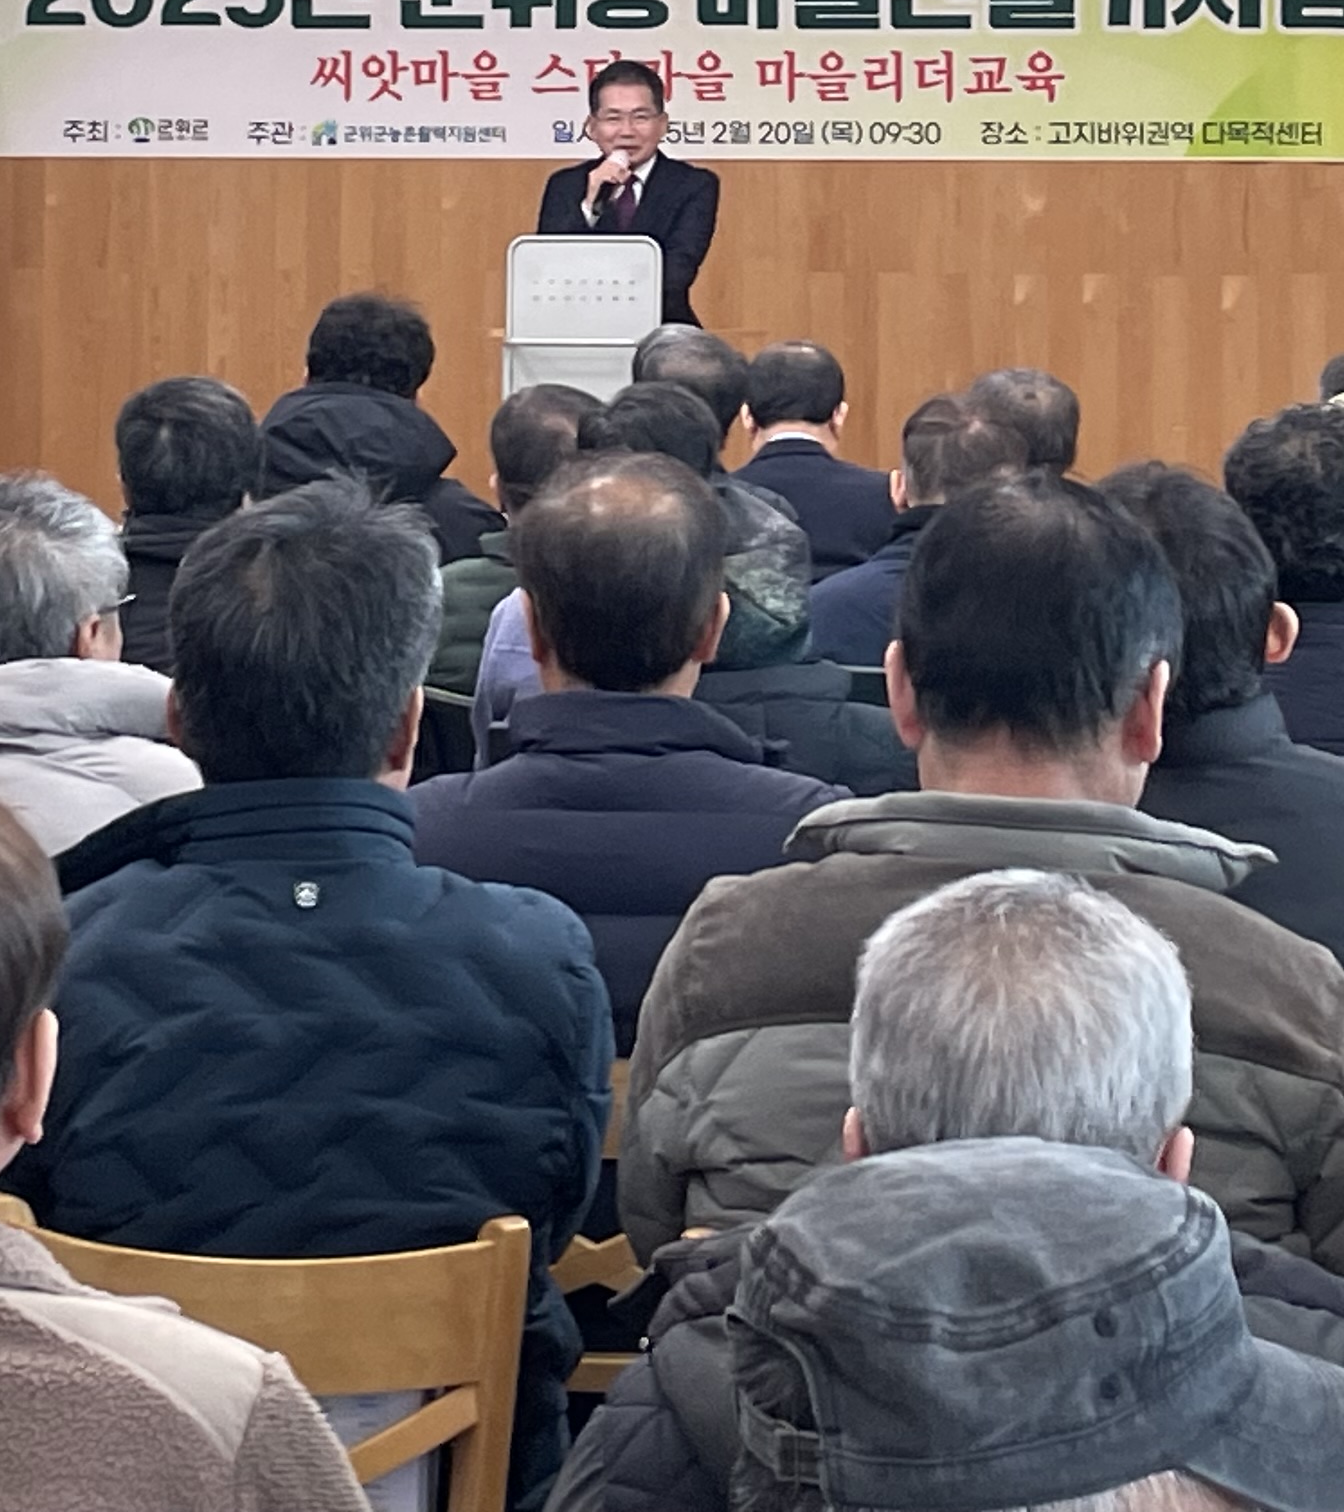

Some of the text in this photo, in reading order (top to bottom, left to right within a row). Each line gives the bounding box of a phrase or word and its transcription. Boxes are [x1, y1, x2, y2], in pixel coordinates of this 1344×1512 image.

[311, 49, 1064, 102] 씨앗마을 스마을 마을리더교육
[63, 120, 109, 144] 주최
[247, 121, 294, 145] 주관
[711, 121, 751, 145] 2월
[758, 121, 815, 145] 20일
[821, 121, 864, 146] (목)
[869, 121, 942, 145] 09:30
[980, 121, 1030, 145] 장소
[1047, 121, 1195, 147] 고지바위권역
[1202, 121, 1323, 147] 다목적센터
